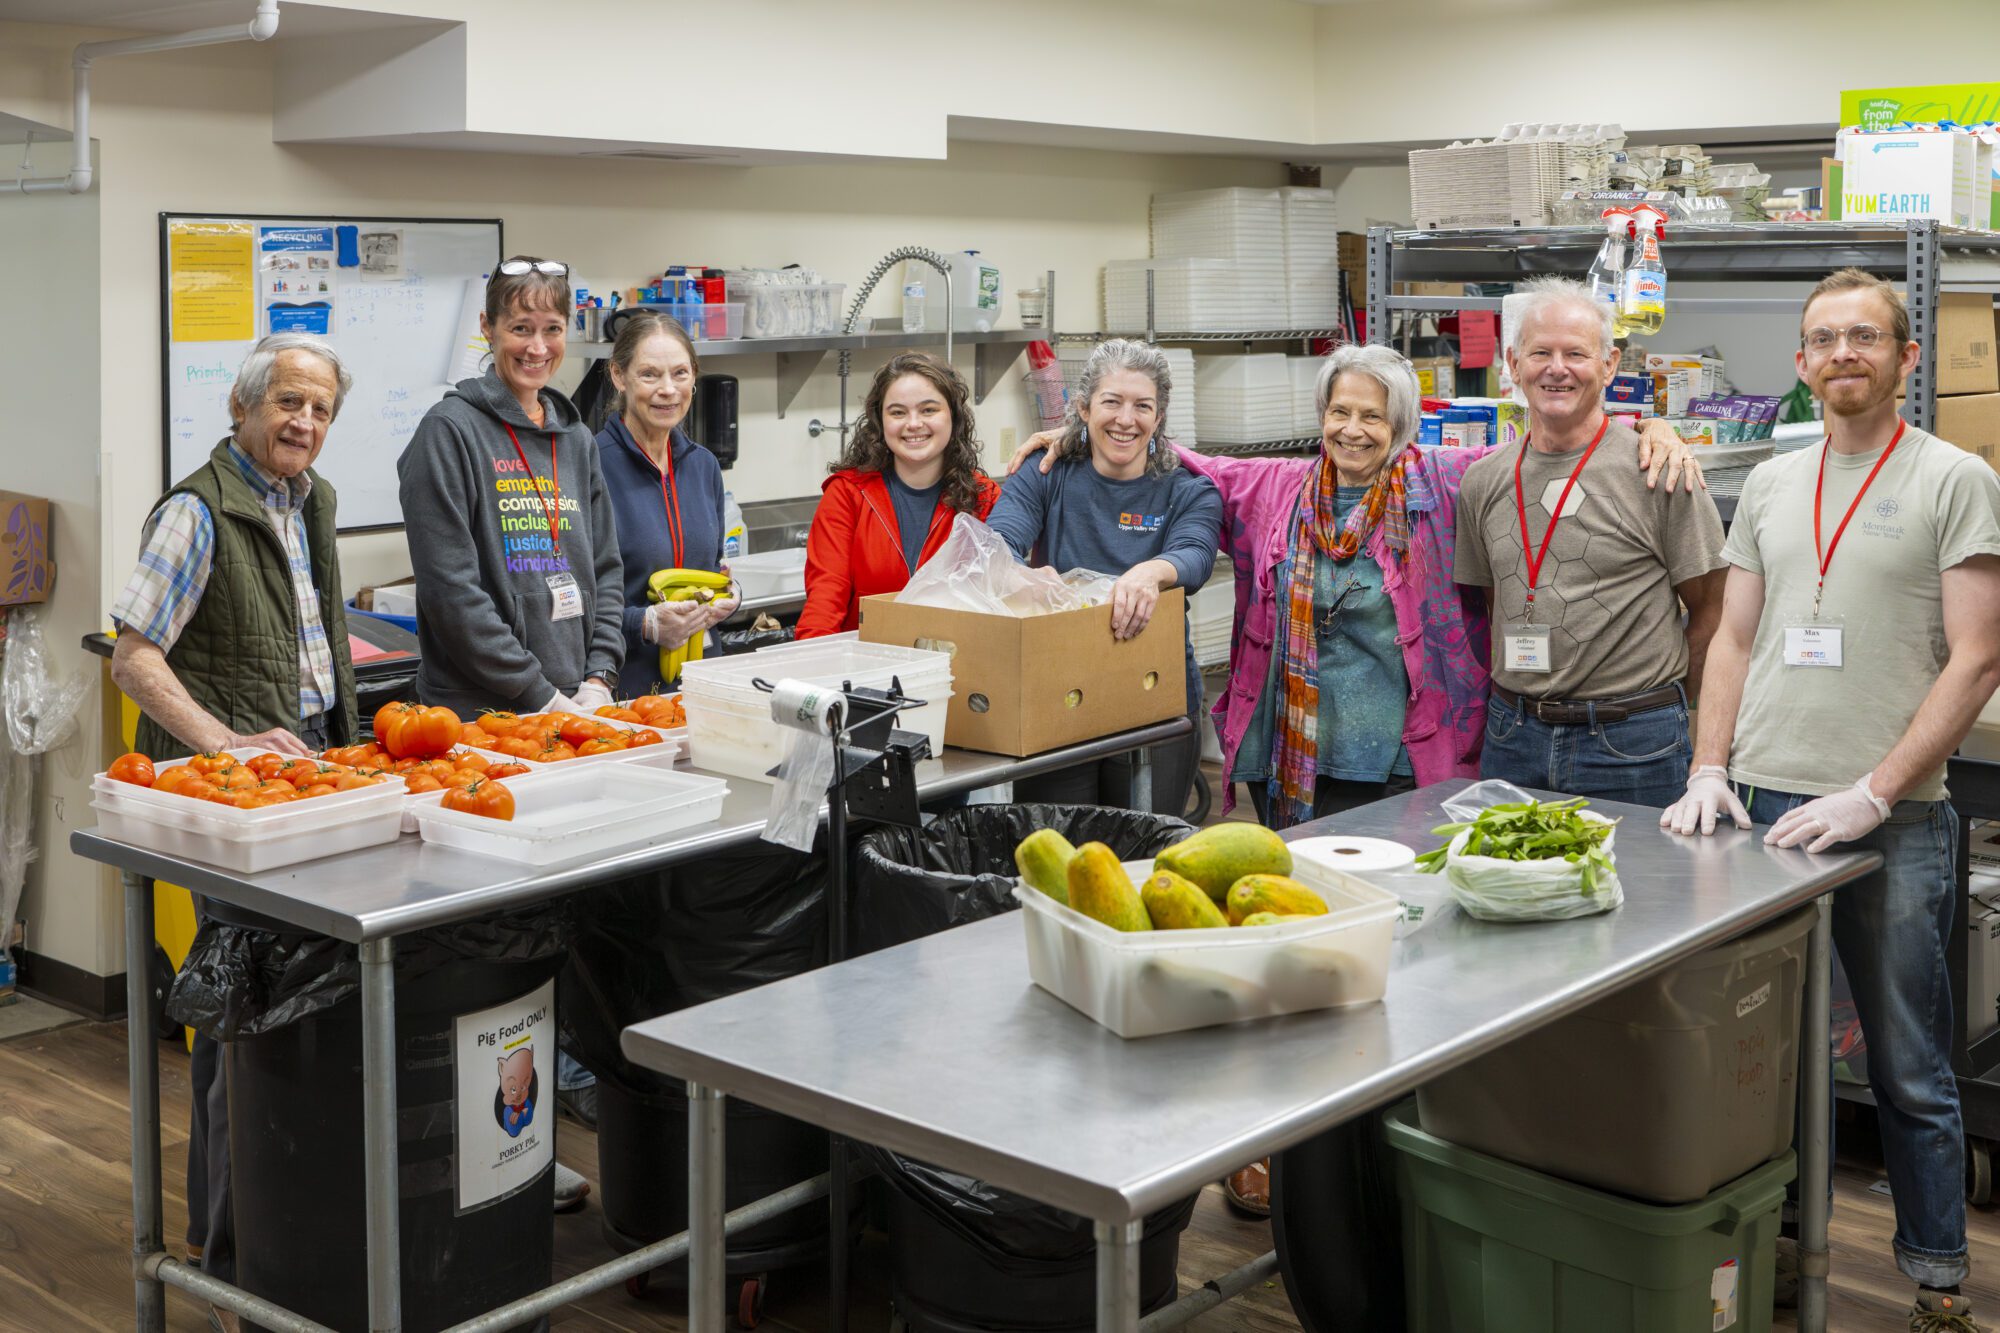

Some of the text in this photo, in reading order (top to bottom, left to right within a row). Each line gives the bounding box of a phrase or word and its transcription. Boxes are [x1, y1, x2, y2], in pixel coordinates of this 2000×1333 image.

[1863, 108, 1893, 120] from
[1593, 191, 1632, 200] ORGANIC
[1845, 193, 1930, 214] YUMEARTH
[271, 233, 323, 242] RECYCLING
[1633, 280, 1662, 293] Windex
[1695, 403, 1733, 418] CAROLINA
[501, 513, 572, 532] inclusn.
[477, 1031, 496, 1047] Pig
[499, 1018, 524, 1040] Food
[526, 1005, 547, 1028] ONLY
[499, 1141, 524, 1161] PORKY
